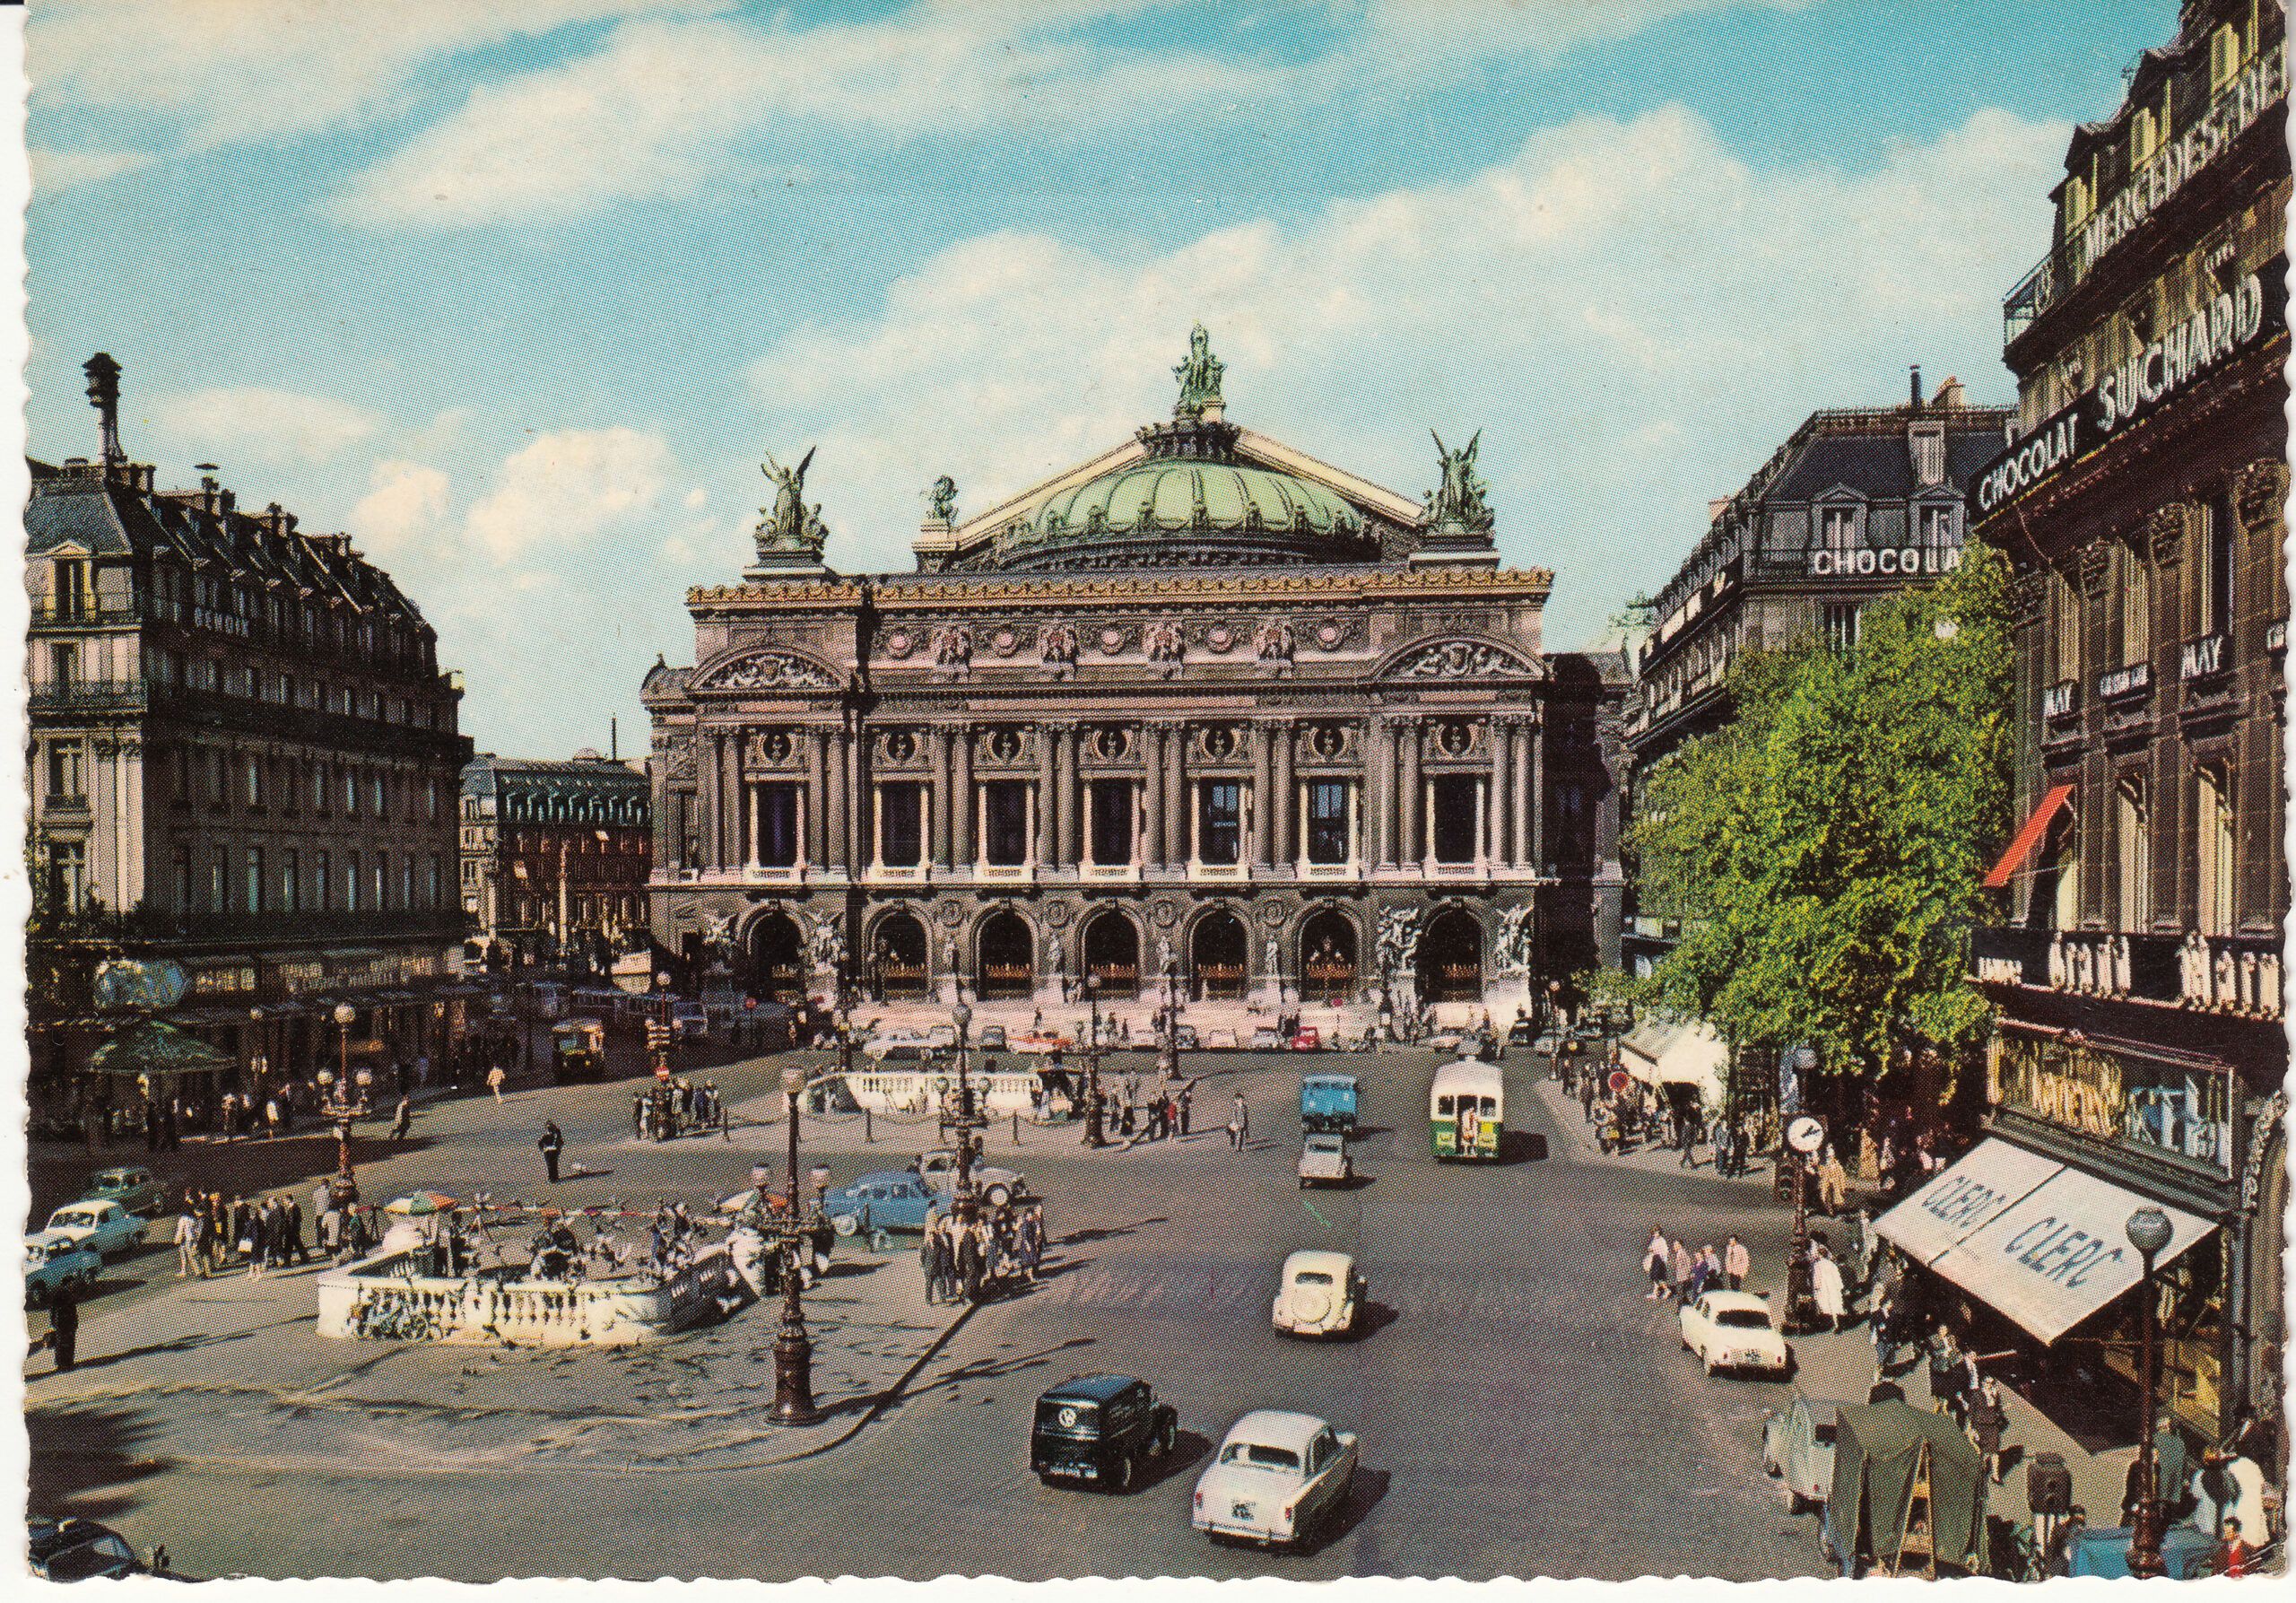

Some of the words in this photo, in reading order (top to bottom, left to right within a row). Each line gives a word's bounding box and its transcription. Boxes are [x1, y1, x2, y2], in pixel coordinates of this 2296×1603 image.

[1979, 412, 2079, 512] CHOCOLAT
[2097, 273, 2264, 431] SUCHARD
[2180, 633, 2225, 680] MAY
[1921, 1173, 2007, 1228] CLERC
[2005, 1215, 2124, 1288] CLERC
